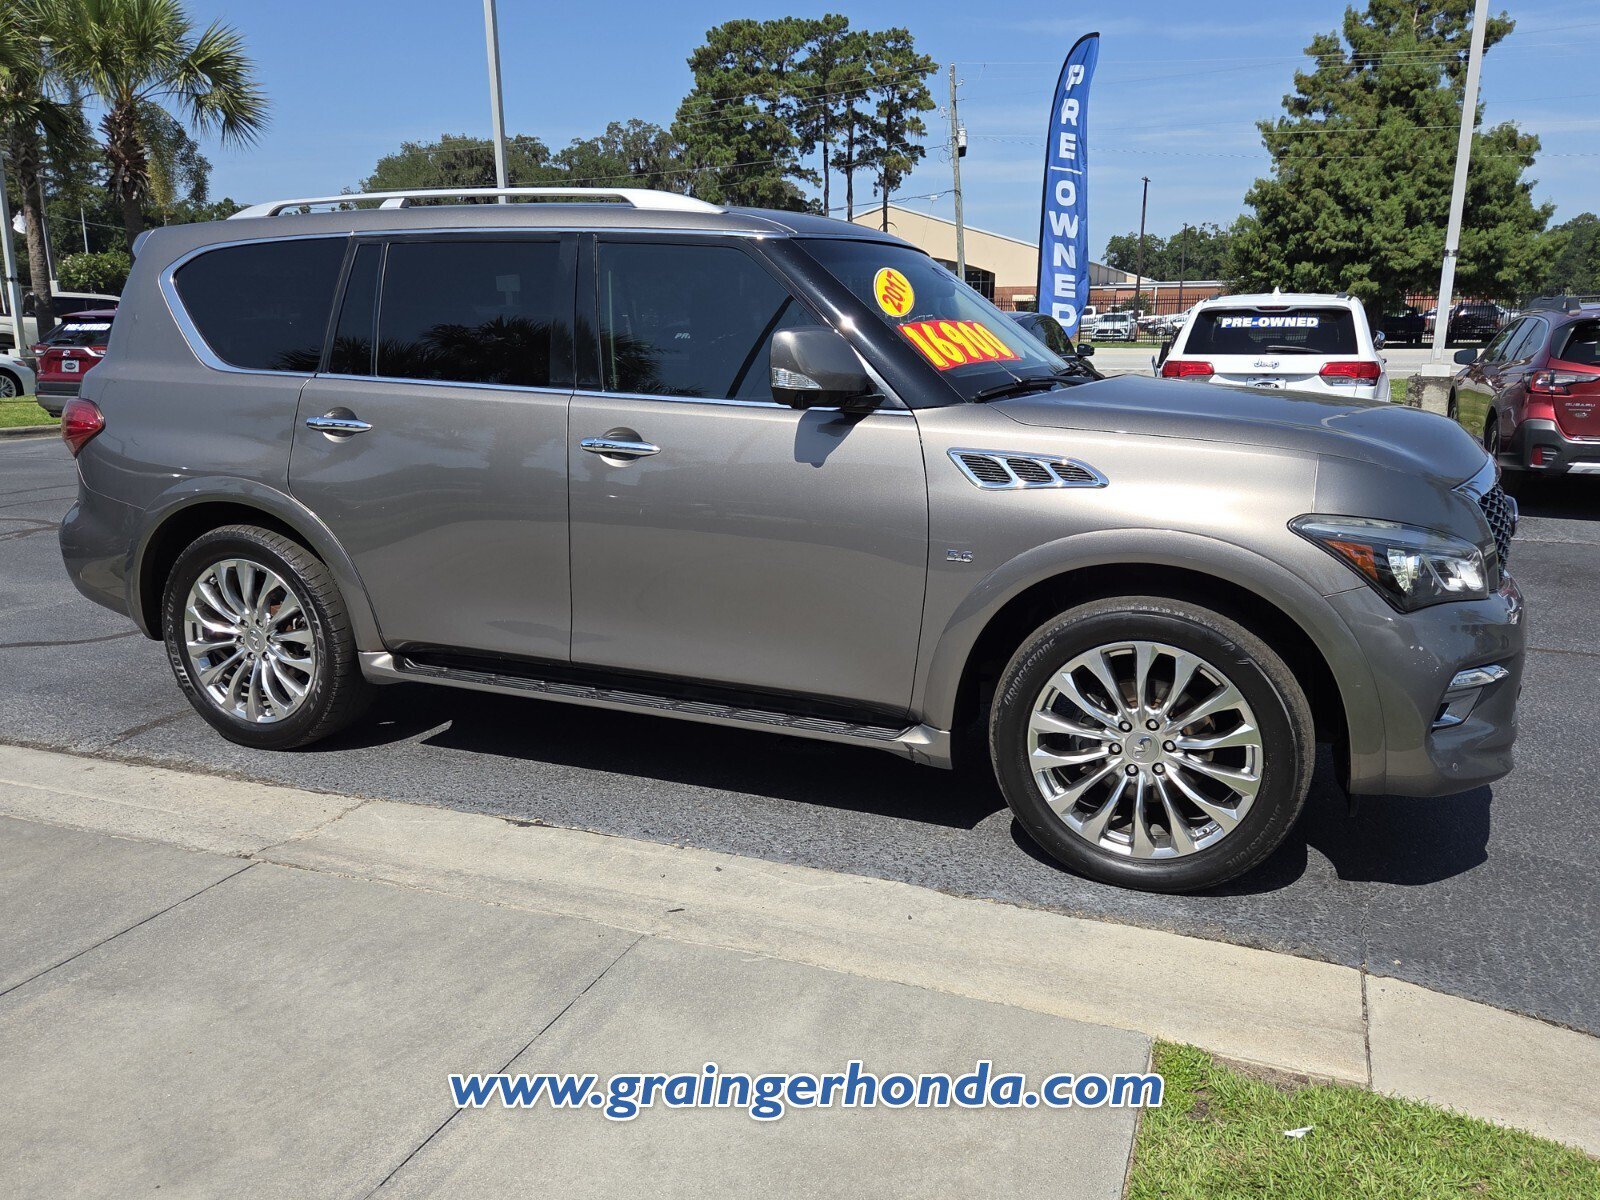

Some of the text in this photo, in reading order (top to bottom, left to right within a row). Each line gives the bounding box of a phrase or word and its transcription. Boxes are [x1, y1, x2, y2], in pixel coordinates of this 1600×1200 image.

[882, 271, 907, 313] 2017
[903, 321, 1015, 367] 16900
[1221, 317, 1319, 328] PRE-OWNED
[1004, 638, 1056, 706] BRIDGESTONE
